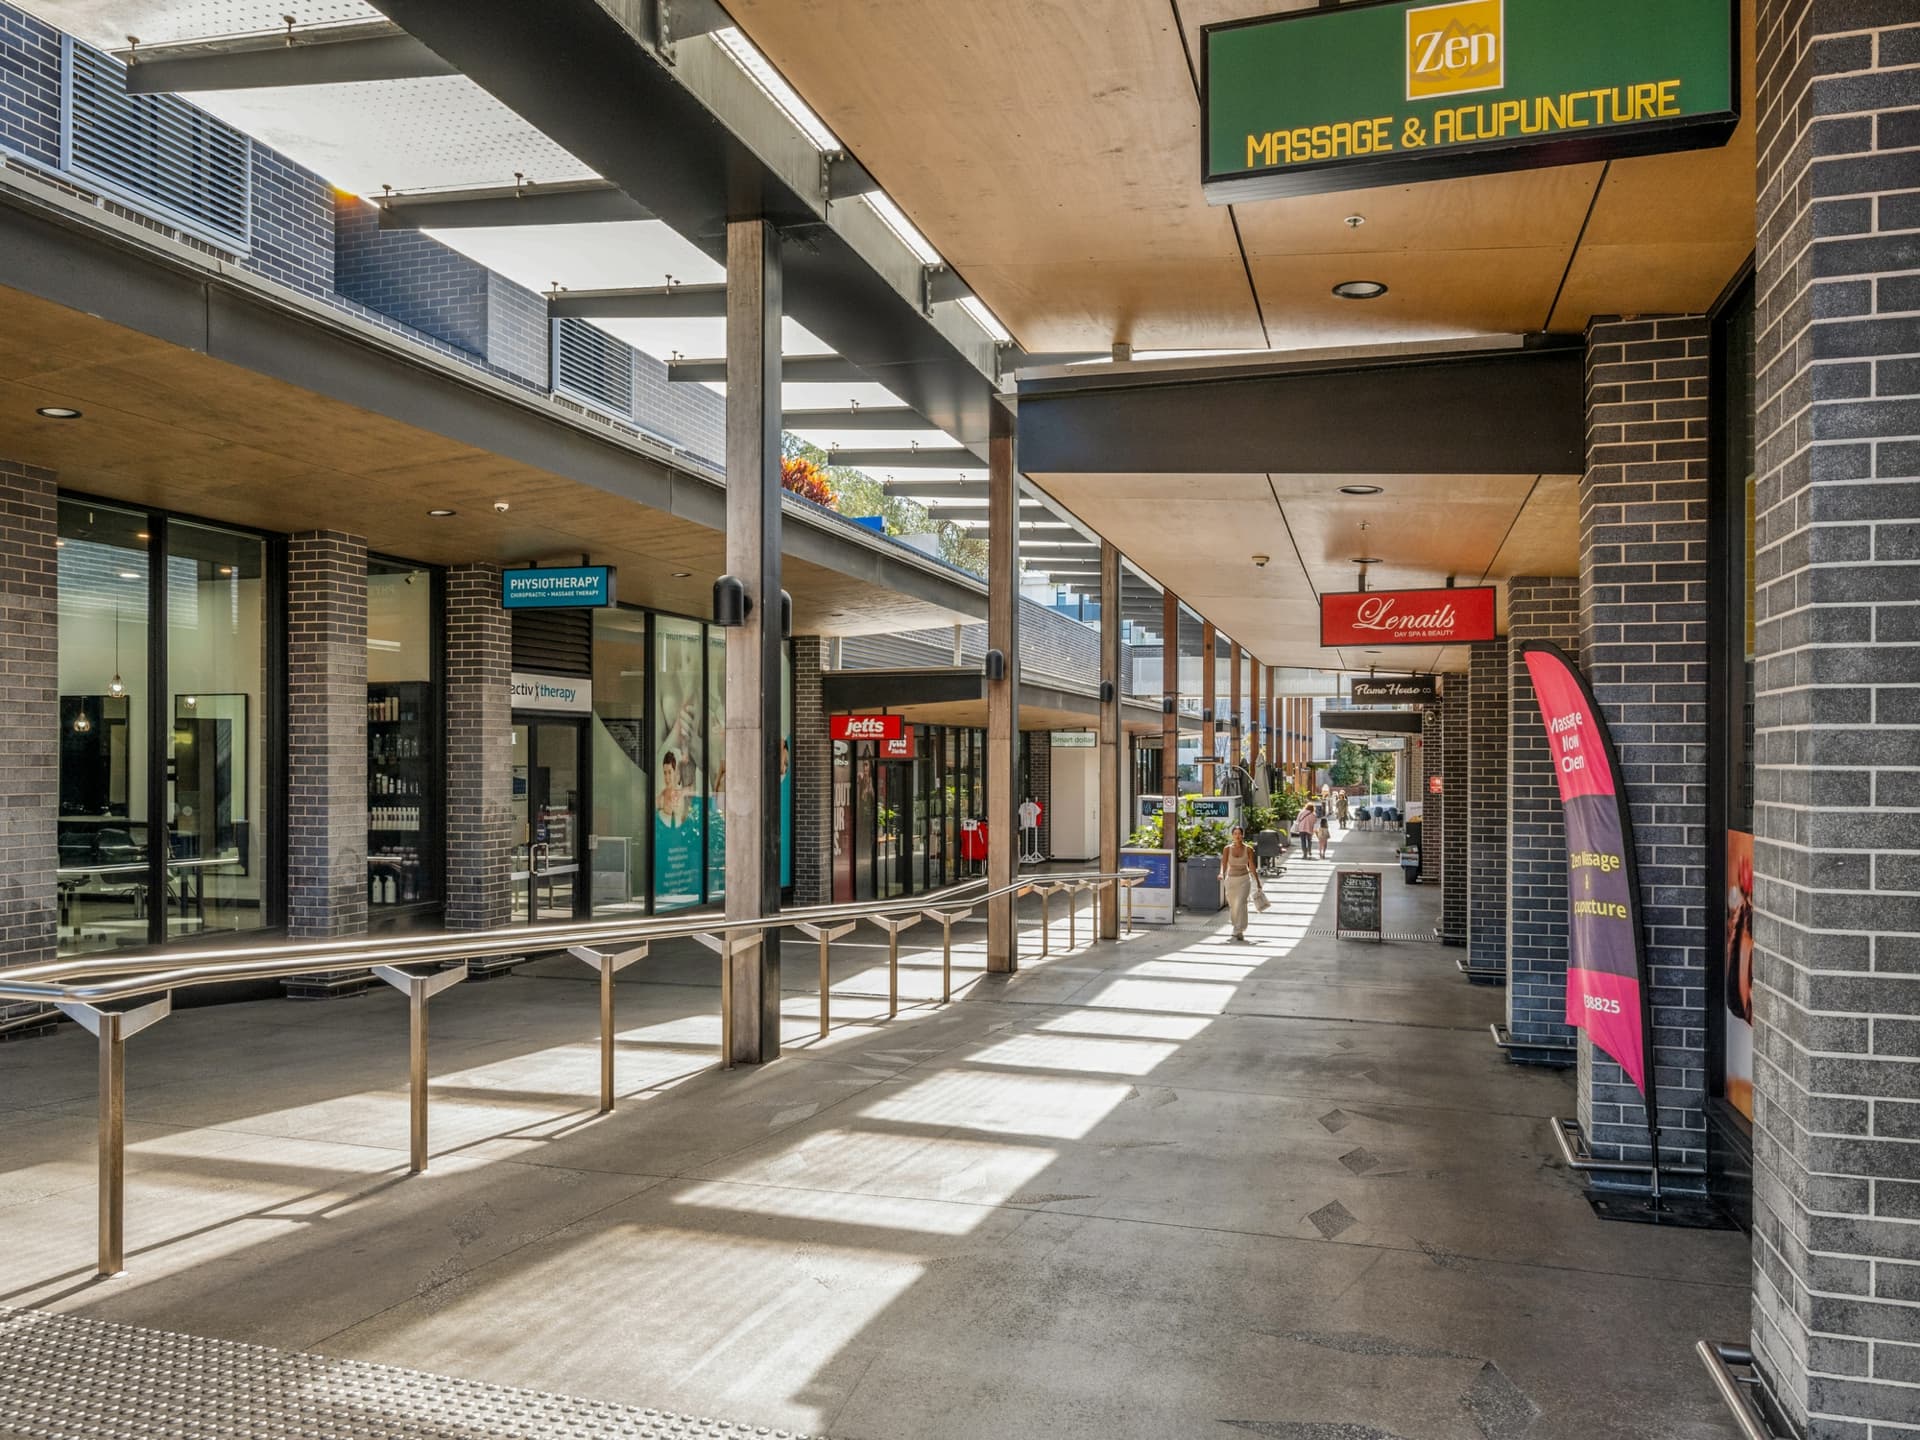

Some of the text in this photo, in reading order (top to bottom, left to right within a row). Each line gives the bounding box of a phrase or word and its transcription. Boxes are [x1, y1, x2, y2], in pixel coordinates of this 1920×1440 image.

[1415, 31, 1496, 73] Zen
[1247, 79, 1681, 168] MASSAGE & ACUPUNCTURE
[510, 576, 600, 590] PHYSIOTHERAPY
[1352, 597, 1456, 631] Lenails
[1354, 683, 1387, 696] Flame
[1386, 682, 1421, 696] House
[845, 718, 884, 736] jetts
[1562, 755, 1585, 773] Oen
